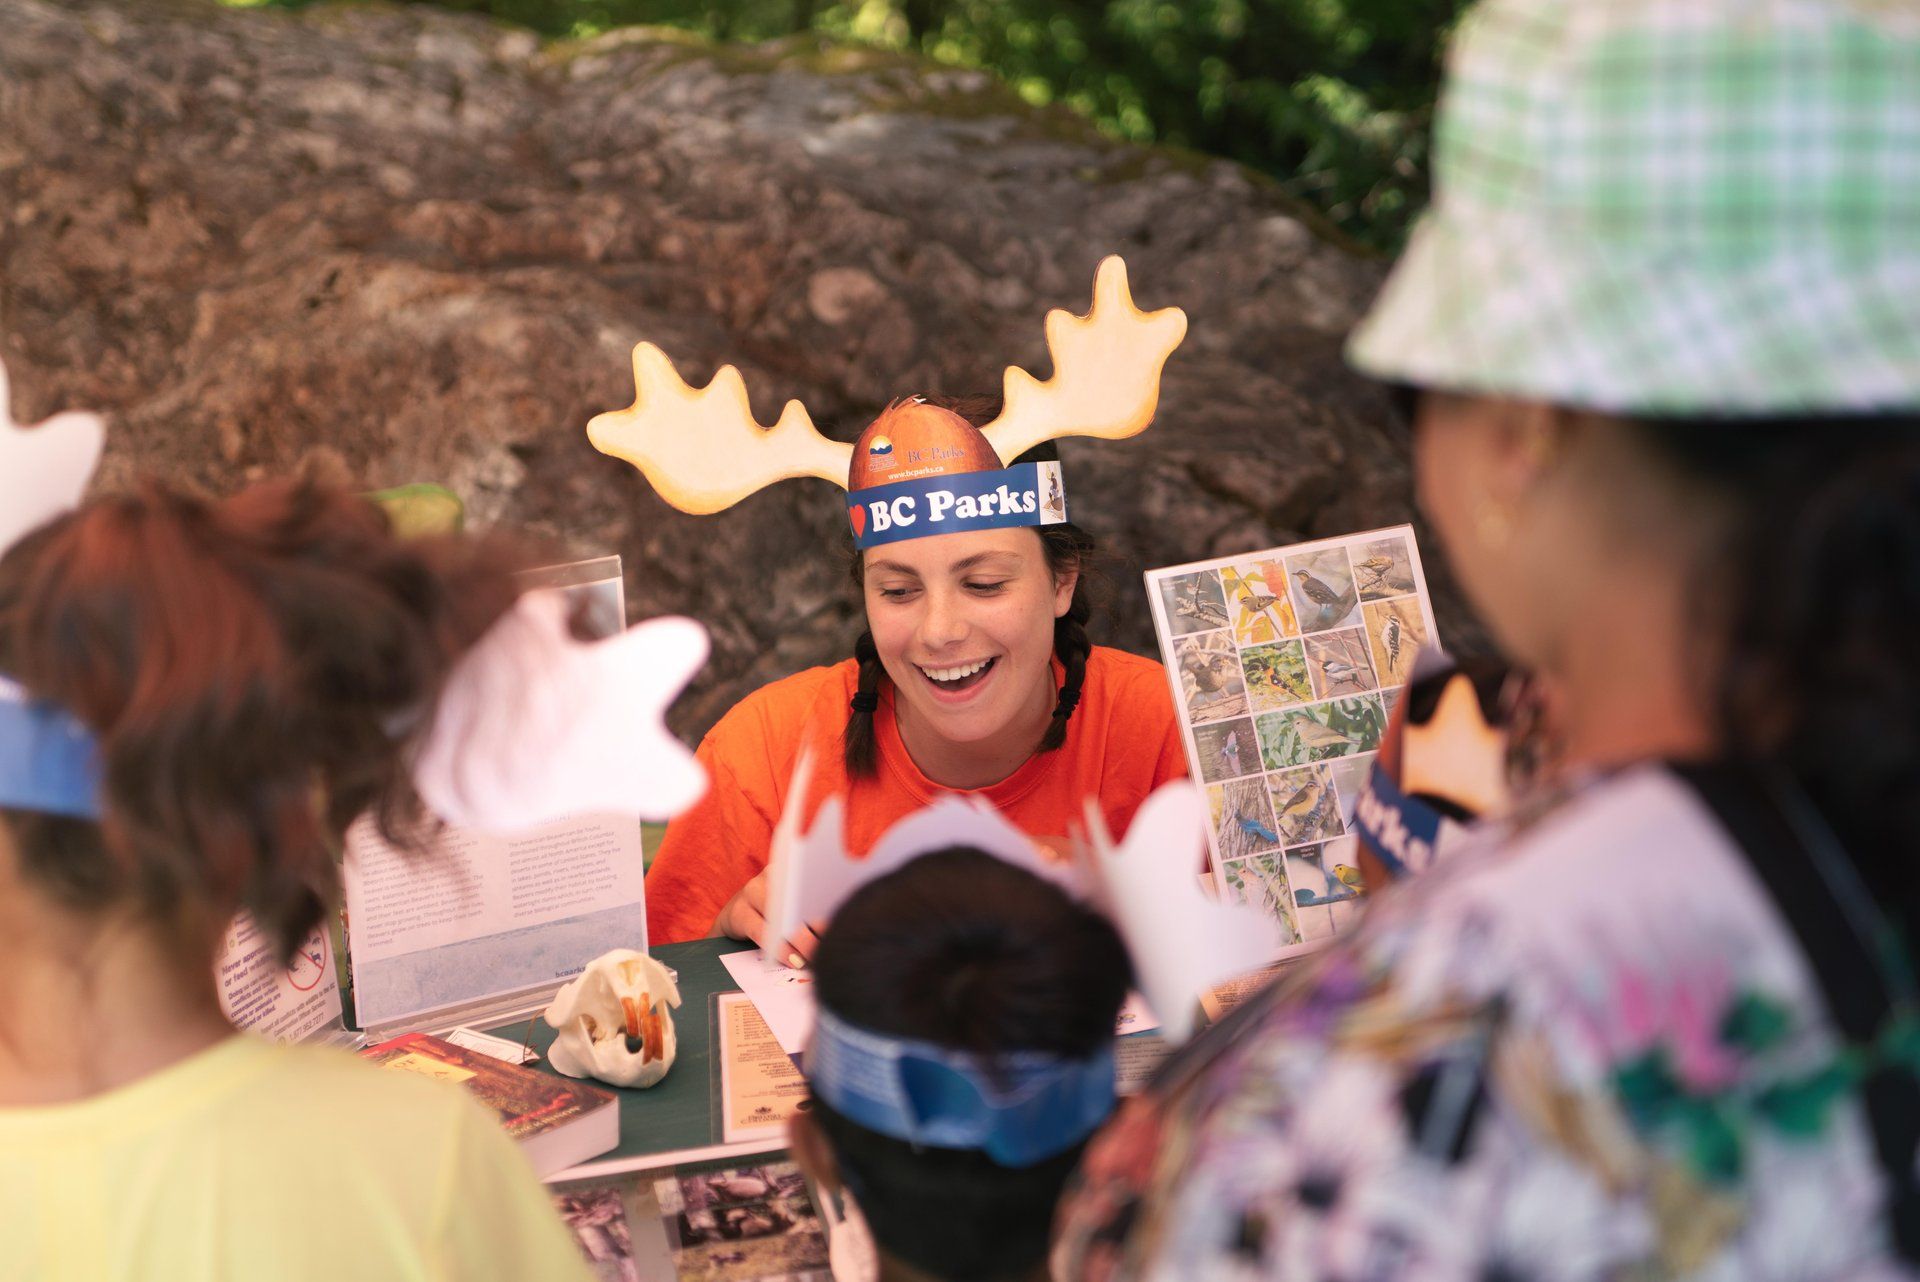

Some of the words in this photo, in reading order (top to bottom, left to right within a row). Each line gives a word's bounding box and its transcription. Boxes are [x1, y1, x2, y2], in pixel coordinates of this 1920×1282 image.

[888, 466, 944, 480] www.bcparks.ca
[869, 496, 916, 532] BC
[926, 484, 1036, 522] Parks
[222, 960, 240, 975] Never
[224, 978, 231, 988] or
[233, 967, 248, 982] feed
